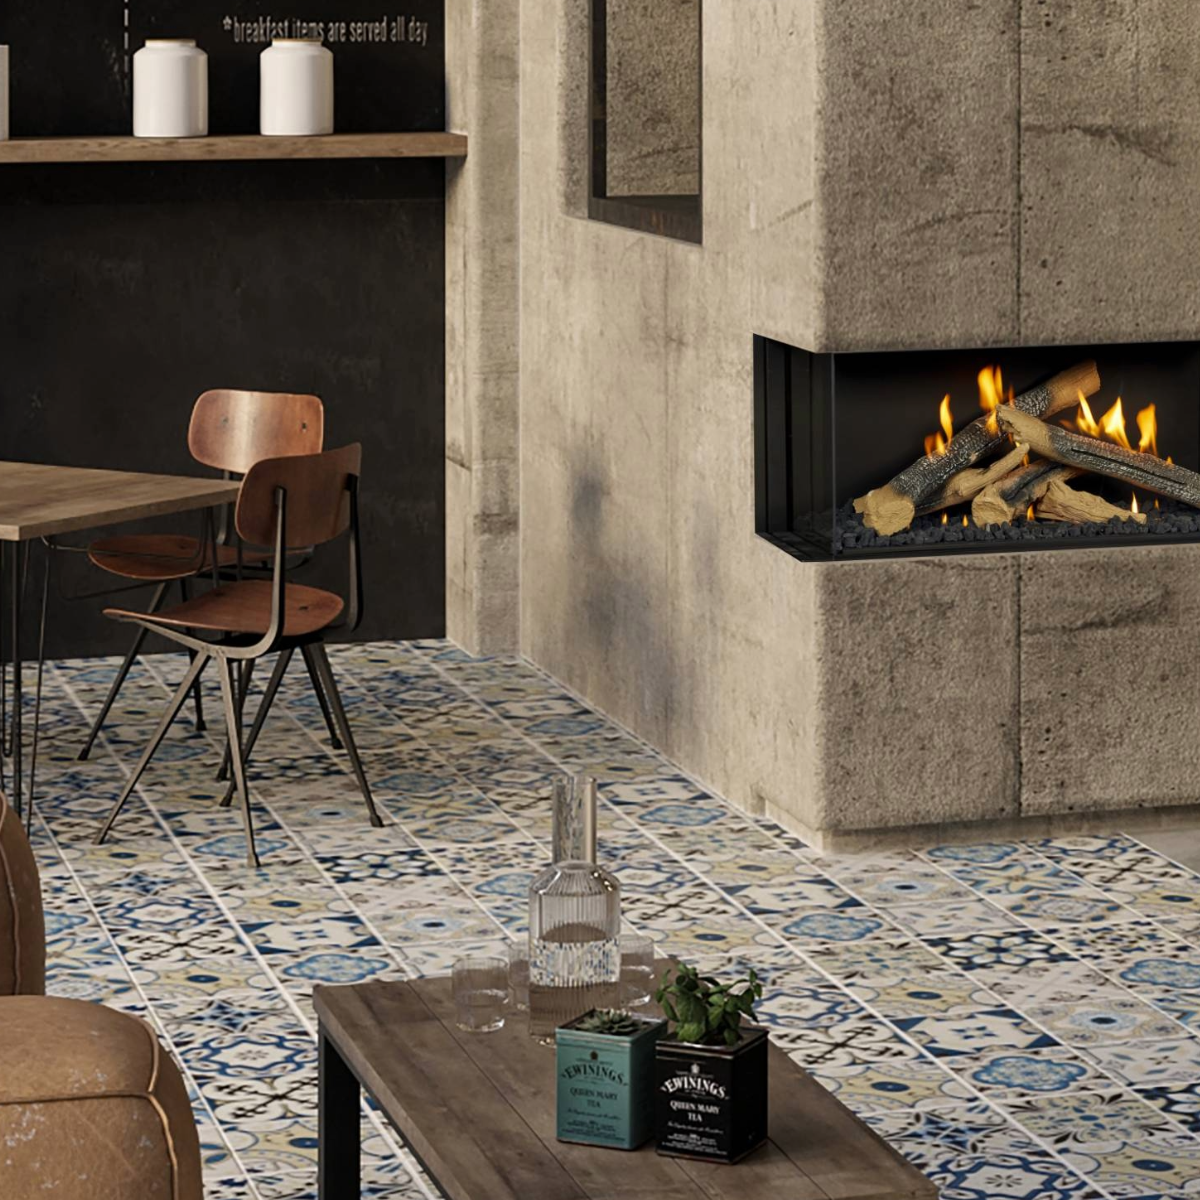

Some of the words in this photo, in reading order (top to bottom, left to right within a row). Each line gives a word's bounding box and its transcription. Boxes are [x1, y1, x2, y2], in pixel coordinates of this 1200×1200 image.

[327, 21, 346, 42] are
[349, 16, 387, 42] served
[390, 16, 405, 42] all
[408, 16, 428, 46] day
